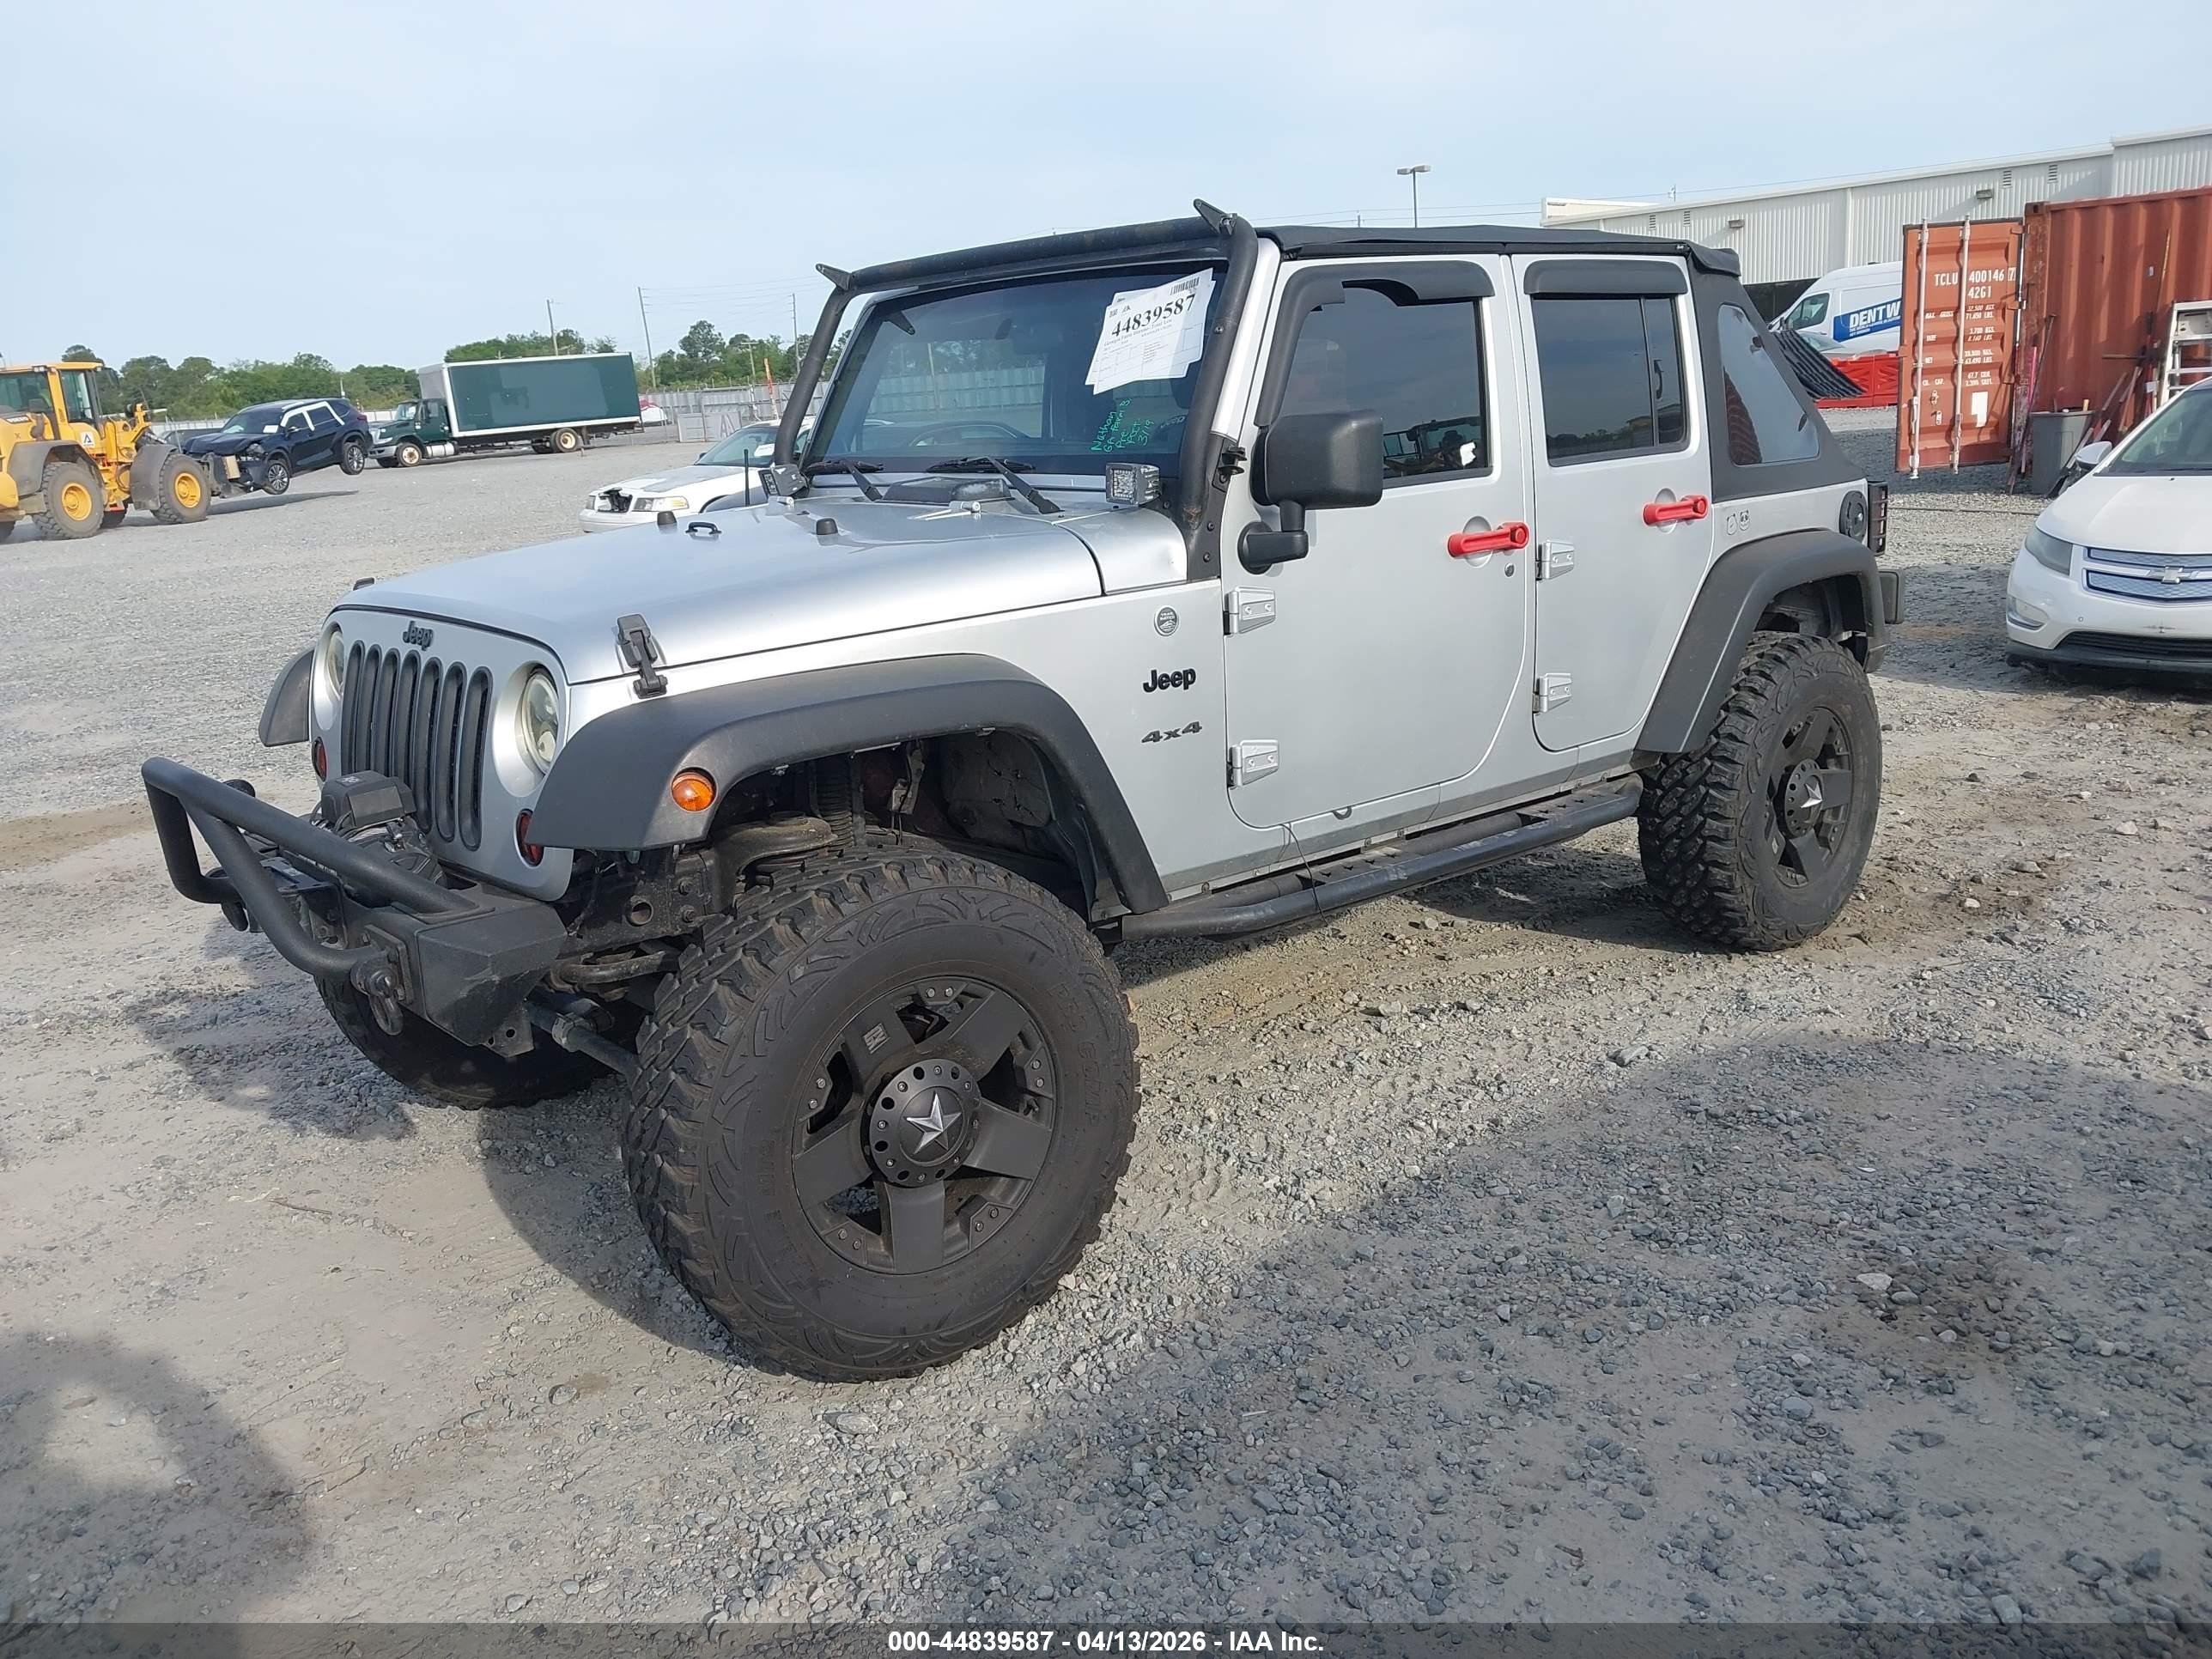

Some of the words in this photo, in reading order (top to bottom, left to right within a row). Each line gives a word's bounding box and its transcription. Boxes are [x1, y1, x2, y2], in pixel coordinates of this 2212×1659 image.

[1934, 271, 1959, 287] TCLU
[1968, 269, 2005, 284] 400146
[2008, 267, 2016, 282] 7
[1967, 285, 1992, 300] 42G1
[1111, 293, 1196, 337] 44839587
[402, 620, 433, 651] Jeep
[1143, 668, 1196, 693] Jeep
[1141, 721, 1203, 744] 4x4
